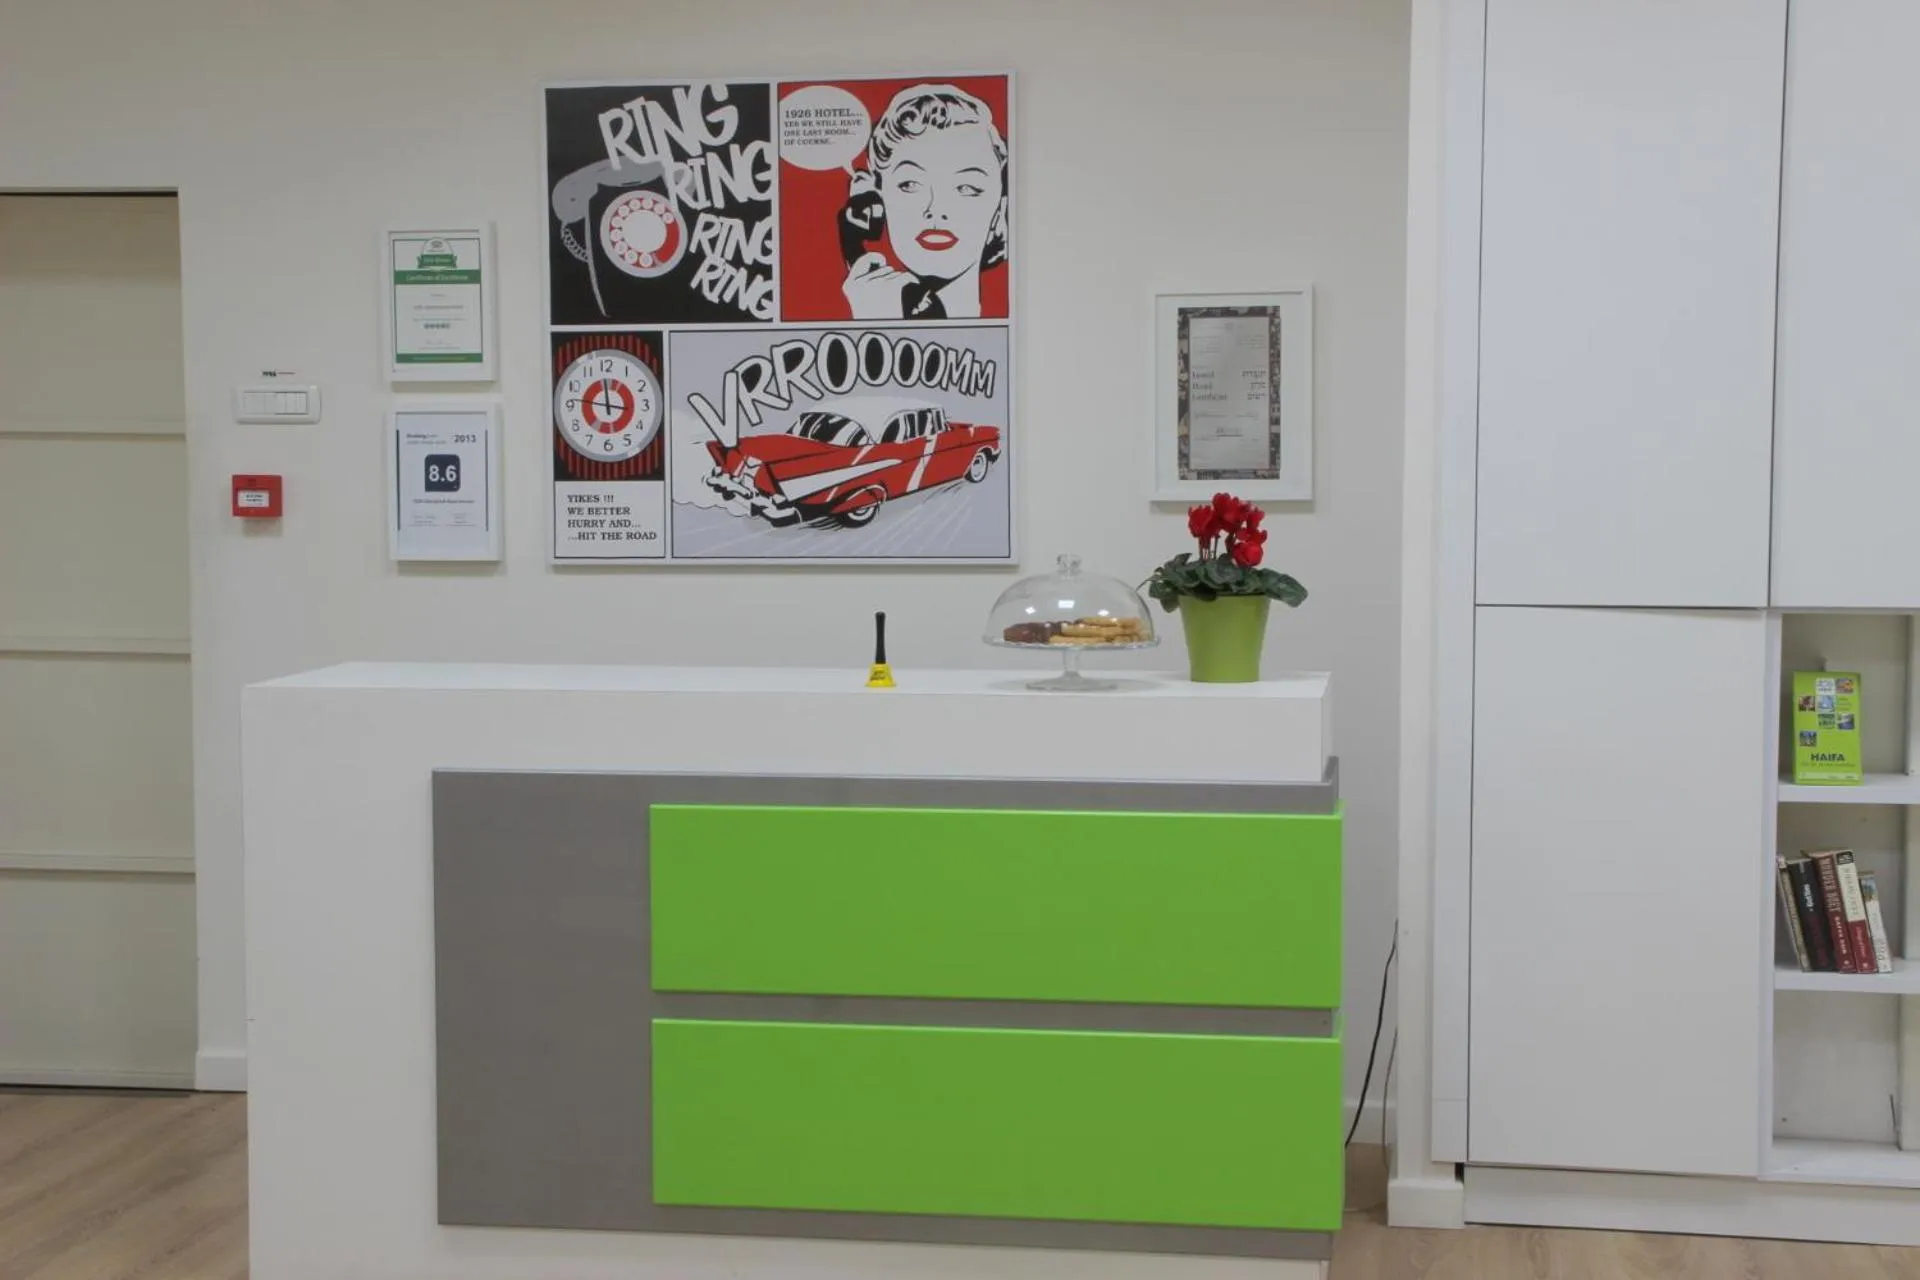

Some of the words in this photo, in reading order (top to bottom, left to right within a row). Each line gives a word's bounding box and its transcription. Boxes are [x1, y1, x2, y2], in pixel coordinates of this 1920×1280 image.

[785, 108, 812, 118] 1926
[598, 84, 739, 170] RING
[784, 129, 801, 137] ONE
[661, 140, 773, 210] RING
[689, 212, 774, 266] RING
[690, 257, 774, 320] RING
[583, 366, 593, 378] 11
[600, 359, 613, 373] 12
[569, 380, 580, 392] 10
[637, 380, 646, 392] 2
[687, 331, 996, 448] VRROOOOMM
[565, 399, 575, 412] 9
[641, 399, 650, 412] 3
[572, 419, 580, 432] 8
[635, 419, 644, 430] 4
[584, 434, 593, 446] 7
[603, 438, 613, 452] 6
[623, 434, 632, 447] 5
[428, 464, 458, 482] 8.6
[567, 494, 600, 503] YIKES
[603, 494, 614, 503] !!!
[567, 506, 584, 515] WE
[587, 506, 631, 515] BETTER
[567, 519, 606, 528] HURRY
[600, 531, 623, 540] THE
[626, 531, 657, 540] ROAD
[1810, 753, 1846, 762] HAIFA
